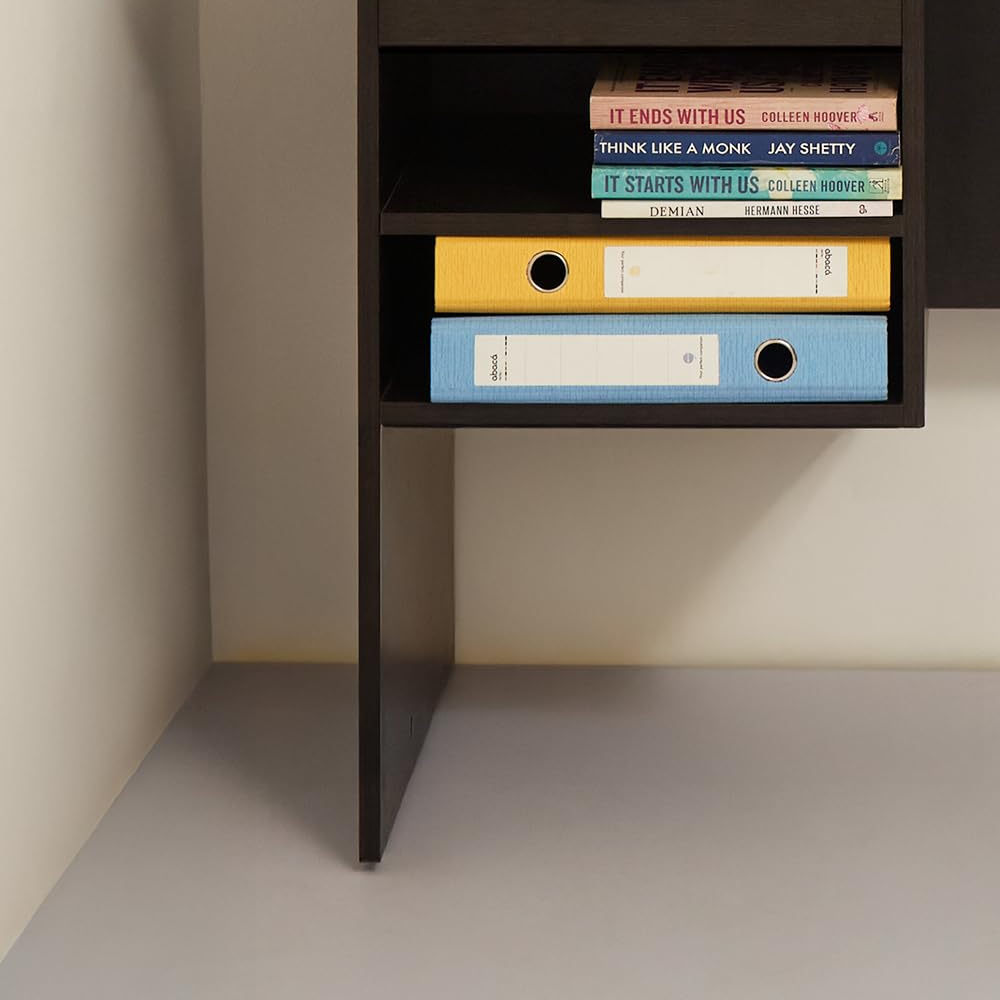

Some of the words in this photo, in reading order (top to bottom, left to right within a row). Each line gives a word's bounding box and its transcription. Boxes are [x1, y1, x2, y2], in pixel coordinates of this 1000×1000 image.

[610, 109, 626, 124] IT
[630, 109, 672, 124] ENDS
[677, 109, 721, 124] WITH
[724, 109, 745, 125] US
[762, 112, 809, 123] COLLEEN
[814, 112, 857, 122] HOOVER
[600, 143, 646, 154] THINK
[652, 143, 681, 154] LIKE
[686, 143, 698, 154] A
[702, 143, 751, 154] MONK
[768, 143, 795, 154] JAY
[800, 143, 856, 154] SHETTY
[604, 176, 620, 192] IT
[625, 176, 684, 193] STARTS
[690, 176, 733, 193] WITH
[738, 177, 759, 194] US
[768, 180, 816, 192] COLLEEN
[821, 181, 865, 192] HOOVER
[650, 207, 704, 216] DEMIAN
[744, 205, 789, 215] HERMANN
[792, 205, 820, 215] HESSE
[824, 248, 833, 276] abacá
[490, 354, 498, 382] abacá
